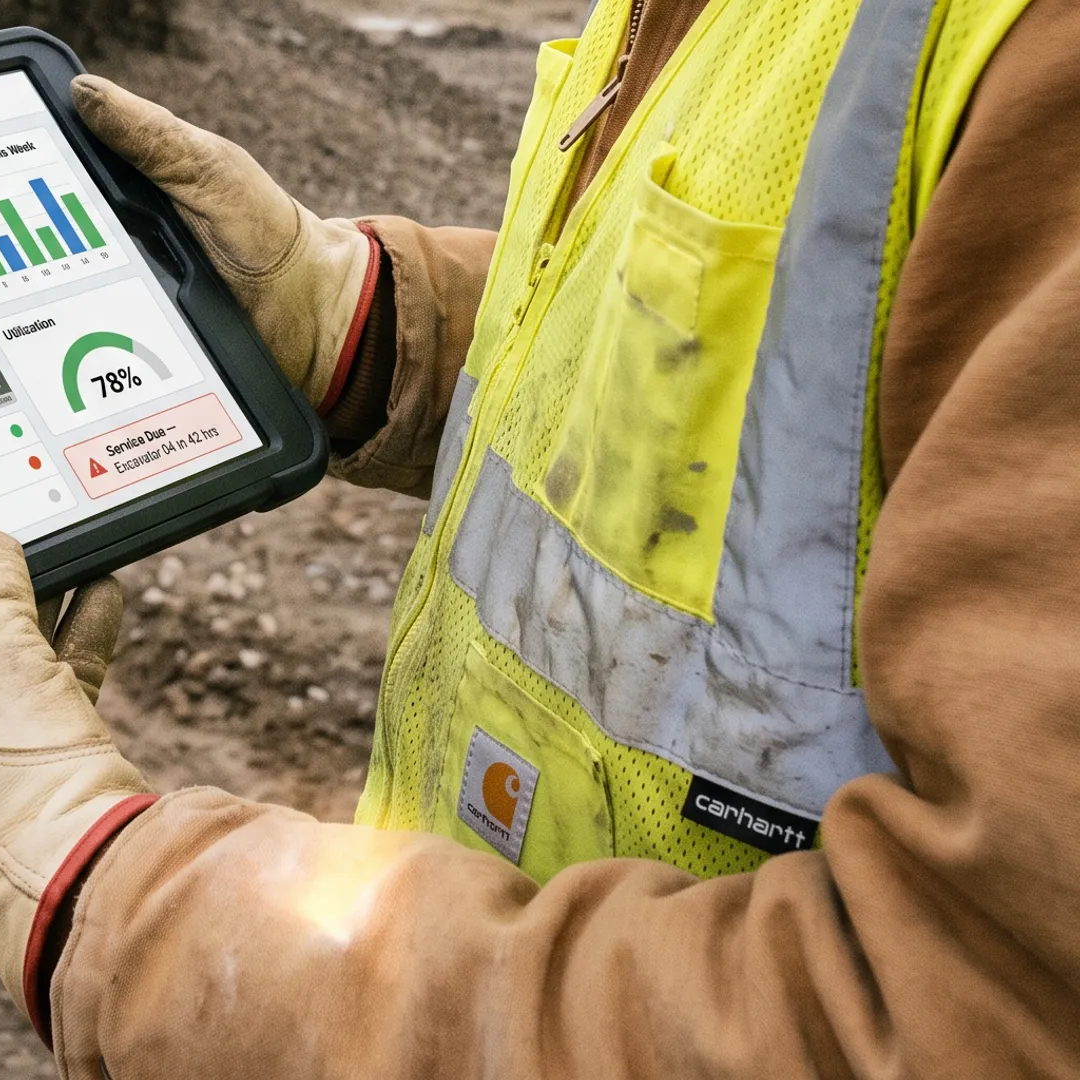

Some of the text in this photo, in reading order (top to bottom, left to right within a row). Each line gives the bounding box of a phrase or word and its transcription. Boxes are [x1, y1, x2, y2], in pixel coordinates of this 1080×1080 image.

[90, 366, 143, 399] 78%
[144, 427, 166, 442] Due
[161, 441, 177, 455] 04
[188, 431, 203, 445] 42
[200, 427, 220, 440] hrs
[695, 793, 806, 849] carhartt
